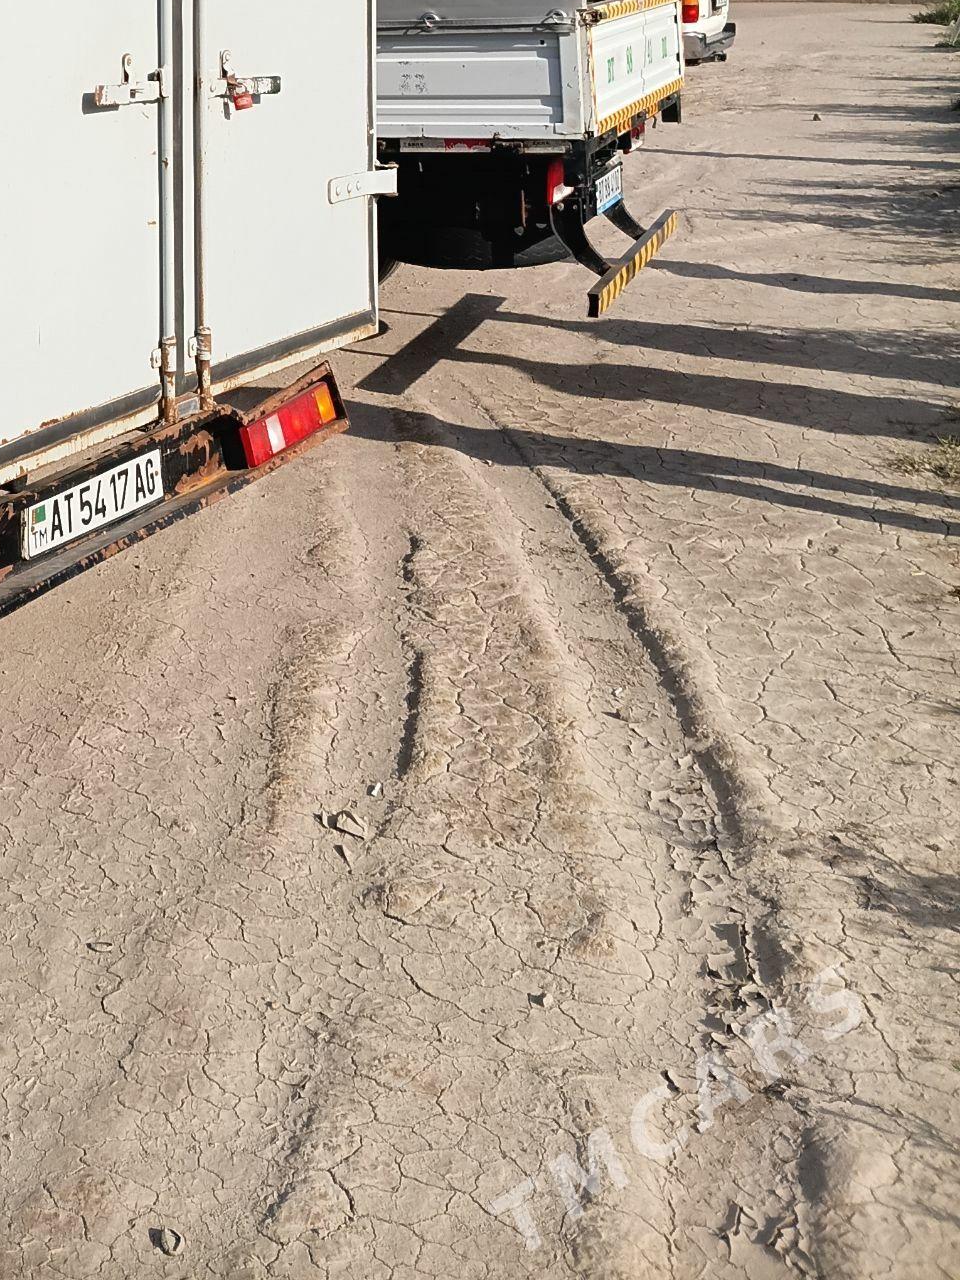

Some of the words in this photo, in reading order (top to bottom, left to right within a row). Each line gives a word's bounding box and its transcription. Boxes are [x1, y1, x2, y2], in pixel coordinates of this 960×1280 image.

[32, 528, 48, 550] TM
[51, 492, 74, 541] AT
[135, 458, 156, 503] AG
